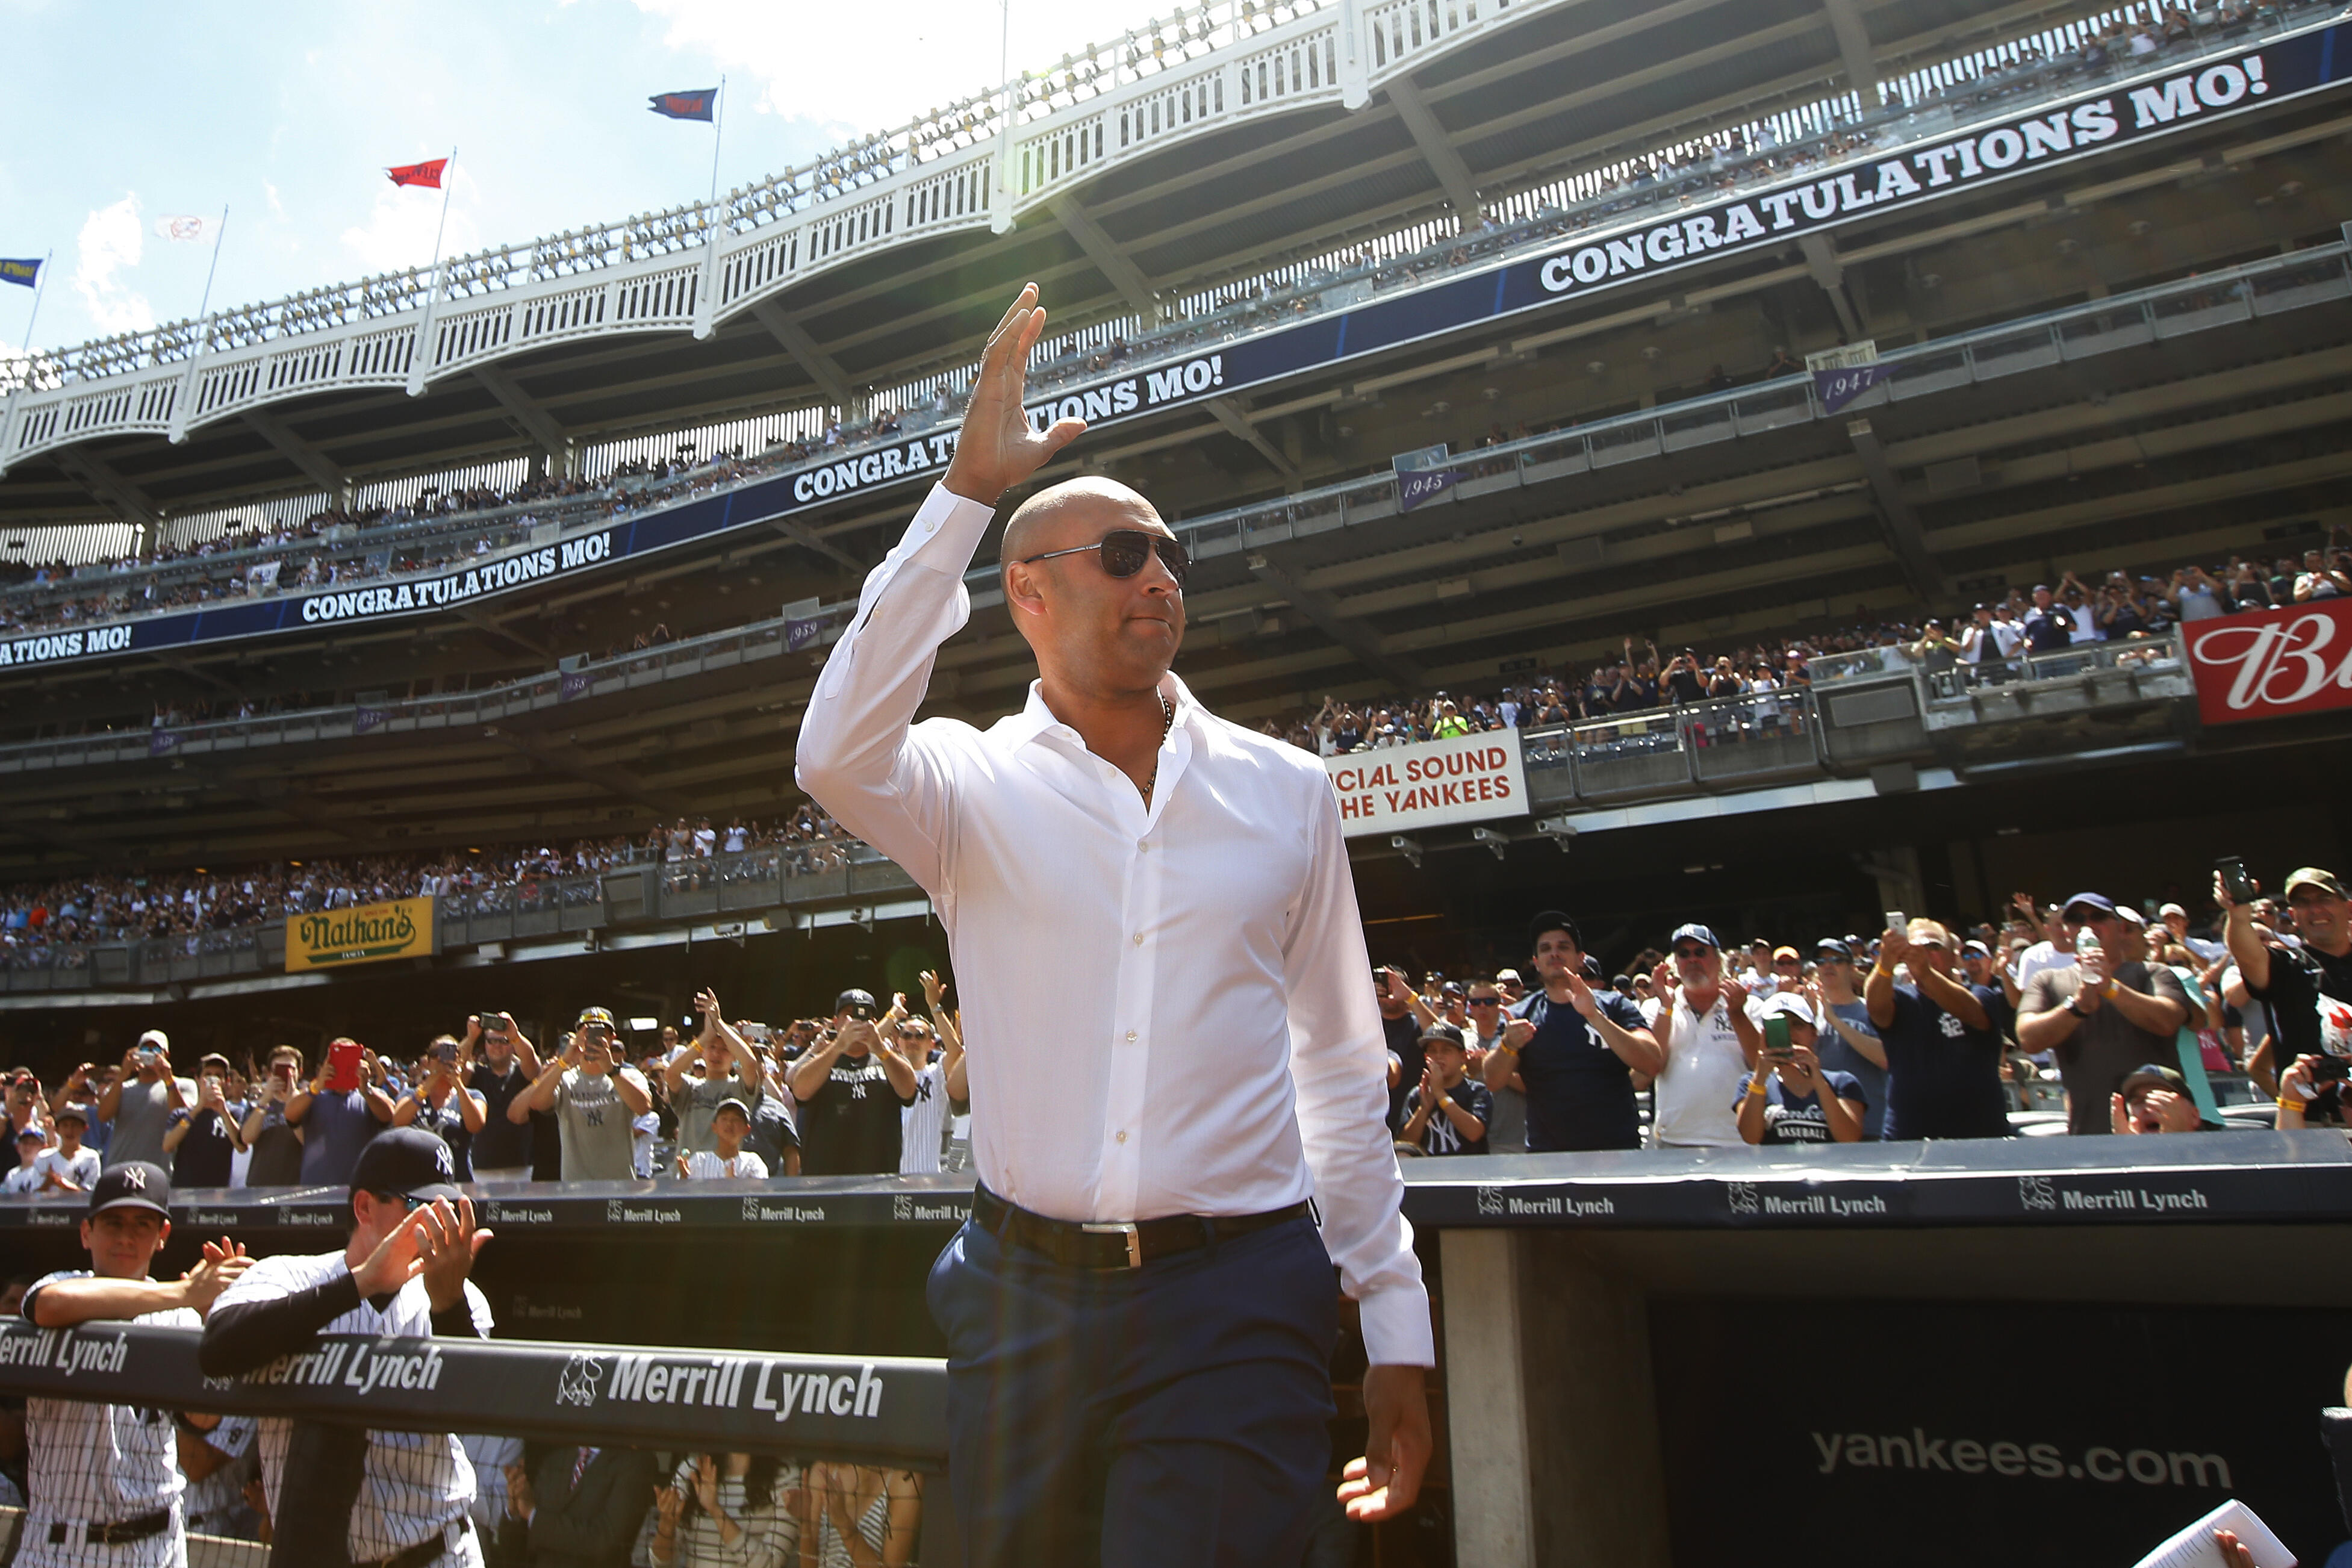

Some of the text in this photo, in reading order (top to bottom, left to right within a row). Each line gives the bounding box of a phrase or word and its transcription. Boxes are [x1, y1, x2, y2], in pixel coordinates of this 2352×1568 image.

[1540, 55, 2270, 293] CONGRATULATIONS MO!
[1825, 369, 1874, 400] 1947
[794, 356, 1223, 503] CONGRATTIONS MO!
[302, 532, 611, 623] CONGRATULATIONS MO!
[86, 625, 132, 653] MO!
[1406, 747, 1507, 782] SOUND
[1384, 775, 1511, 813] YANKEES
[300, 904, 416, 950] Nathan's
[852, 1083, 867, 1099] NY
[1777, 1127, 1826, 1139] BASEBALL
[435, 1144, 453, 1175] NY
[123, 1166, 146, 1189] NY
[761, 1207, 825, 1222] Merrill Lynch
[915, 1205, 951, 1220] Merrill
[1509, 1197, 1615, 1217] Merrill Lynch
[1764, 1195, 1887, 1218] Merrill Lynch
[2062, 1189, 2209, 1212] Merrill Lynch
[500, 1210, 553, 1224] Merrill Lynch
[623, 1209, 681, 1224] Merrill Lynch
[0, 1327, 128, 1377] errill Lynch
[344, 1343, 444, 1394] Lynch
[608, 1352, 884, 1422] Merrill Lynch
[1811, 1427, 2233, 1489] yankees.com
